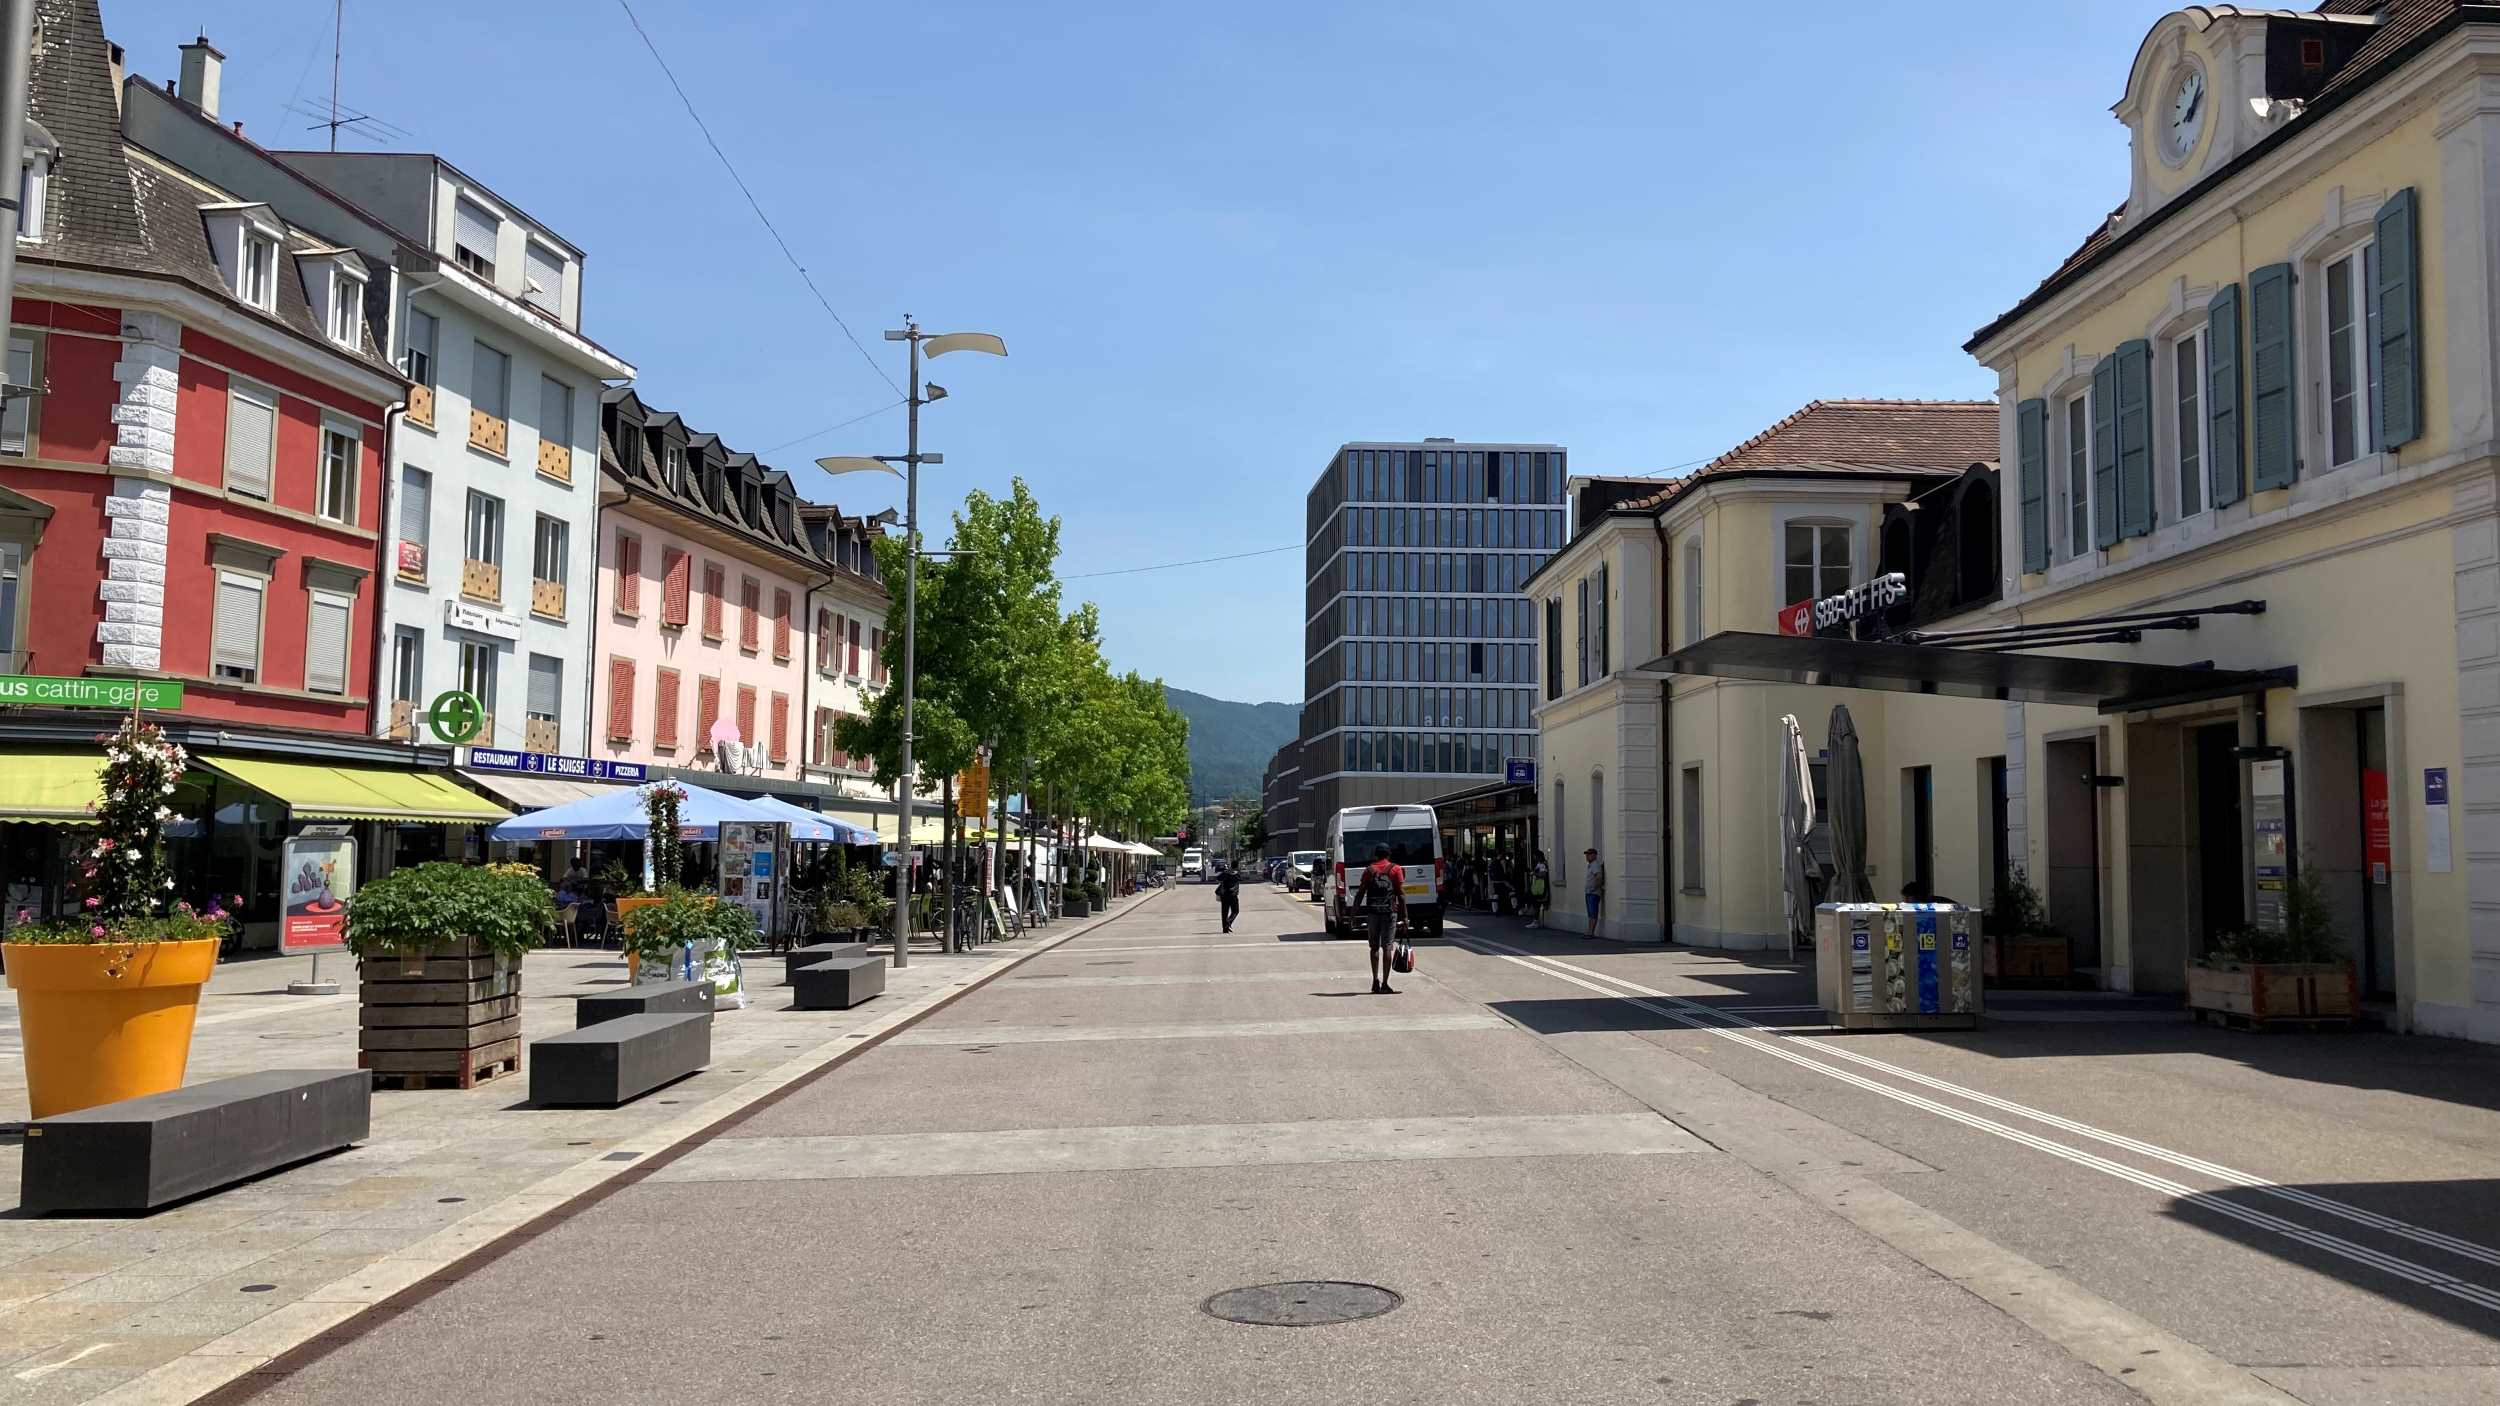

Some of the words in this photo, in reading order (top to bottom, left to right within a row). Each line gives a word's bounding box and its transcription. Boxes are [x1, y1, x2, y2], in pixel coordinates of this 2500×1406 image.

[1815, 596, 1842, 630] SBB
[1843, 583, 1868, 620] CFF
[1871, 573, 1907, 610] FFS
[35, 681, 160, 705] cattin-gare
[473, 751, 519, 767] RESTAURANT
[547, 757, 558, 772] LE
[615, 765, 640, 777] PIZZERIA
